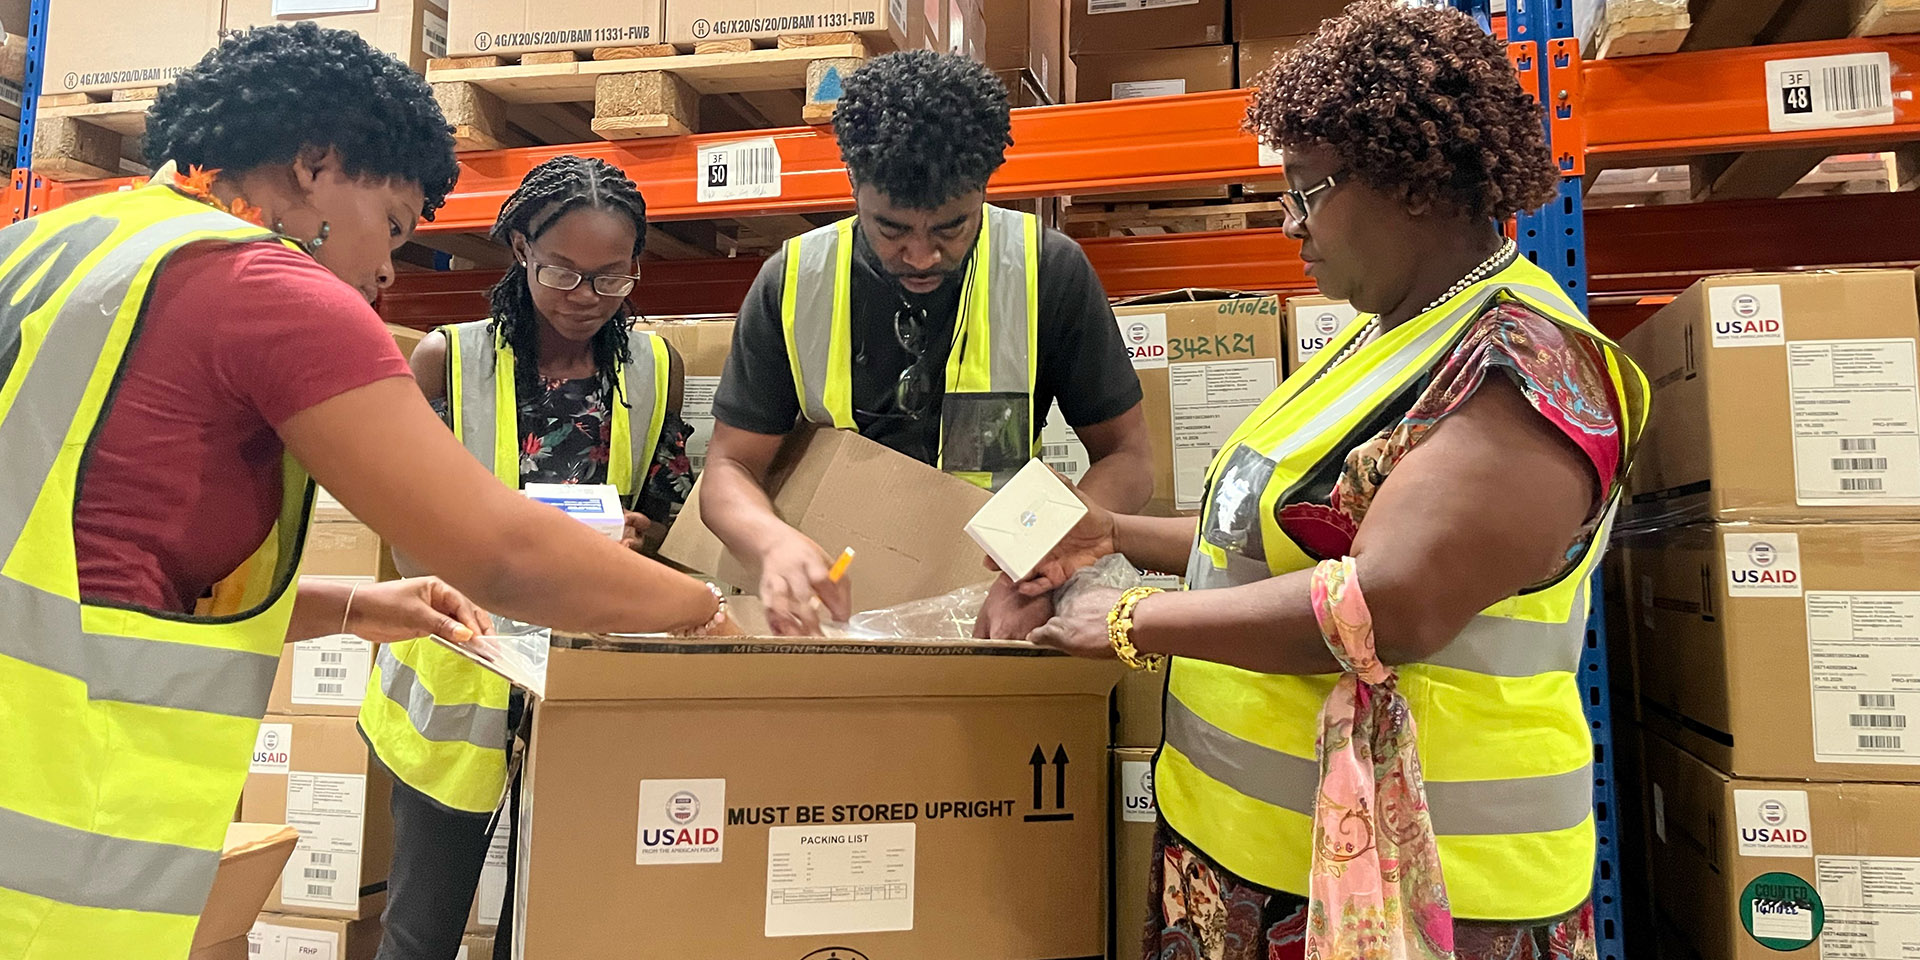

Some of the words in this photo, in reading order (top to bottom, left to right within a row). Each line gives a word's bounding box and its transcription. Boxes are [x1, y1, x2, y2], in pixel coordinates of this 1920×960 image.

[713, 15, 815, 34] 4G/X20/S/20/D/BAM
[817, 11, 875, 27] 11331-FWB
[494, 29, 592, 47] 4G/X20/S/20/D/BAM
[595, 26, 650, 42] 11331-FWB
[1789, 74, 1803, 85] 3F
[1787, 88, 1808, 108] 48
[713, 154, 723, 163] 3F
[711, 165, 725, 183] 50
[1716, 320, 1780, 334] USAID
[1127, 345, 1164, 358] SAID
[1732, 570, 1797, 583] USAID
[732, 645, 877, 654] MISSIONPHARMA
[893, 646, 974, 655] DENMARK
[253, 752, 288, 763] USAID
[727, 806, 790, 825] MUST
[796, 805, 826, 823] BE
[831, 803, 918, 822] STORED
[925, 800, 1016, 819] UPRIGHT
[643, 828, 719, 846] USAID
[800, 835, 845, 845] PACKING
[848, 834, 869, 843] LIST
[1742, 828, 1807, 842] USAID
[1755, 883, 1808, 900] COUNTED
